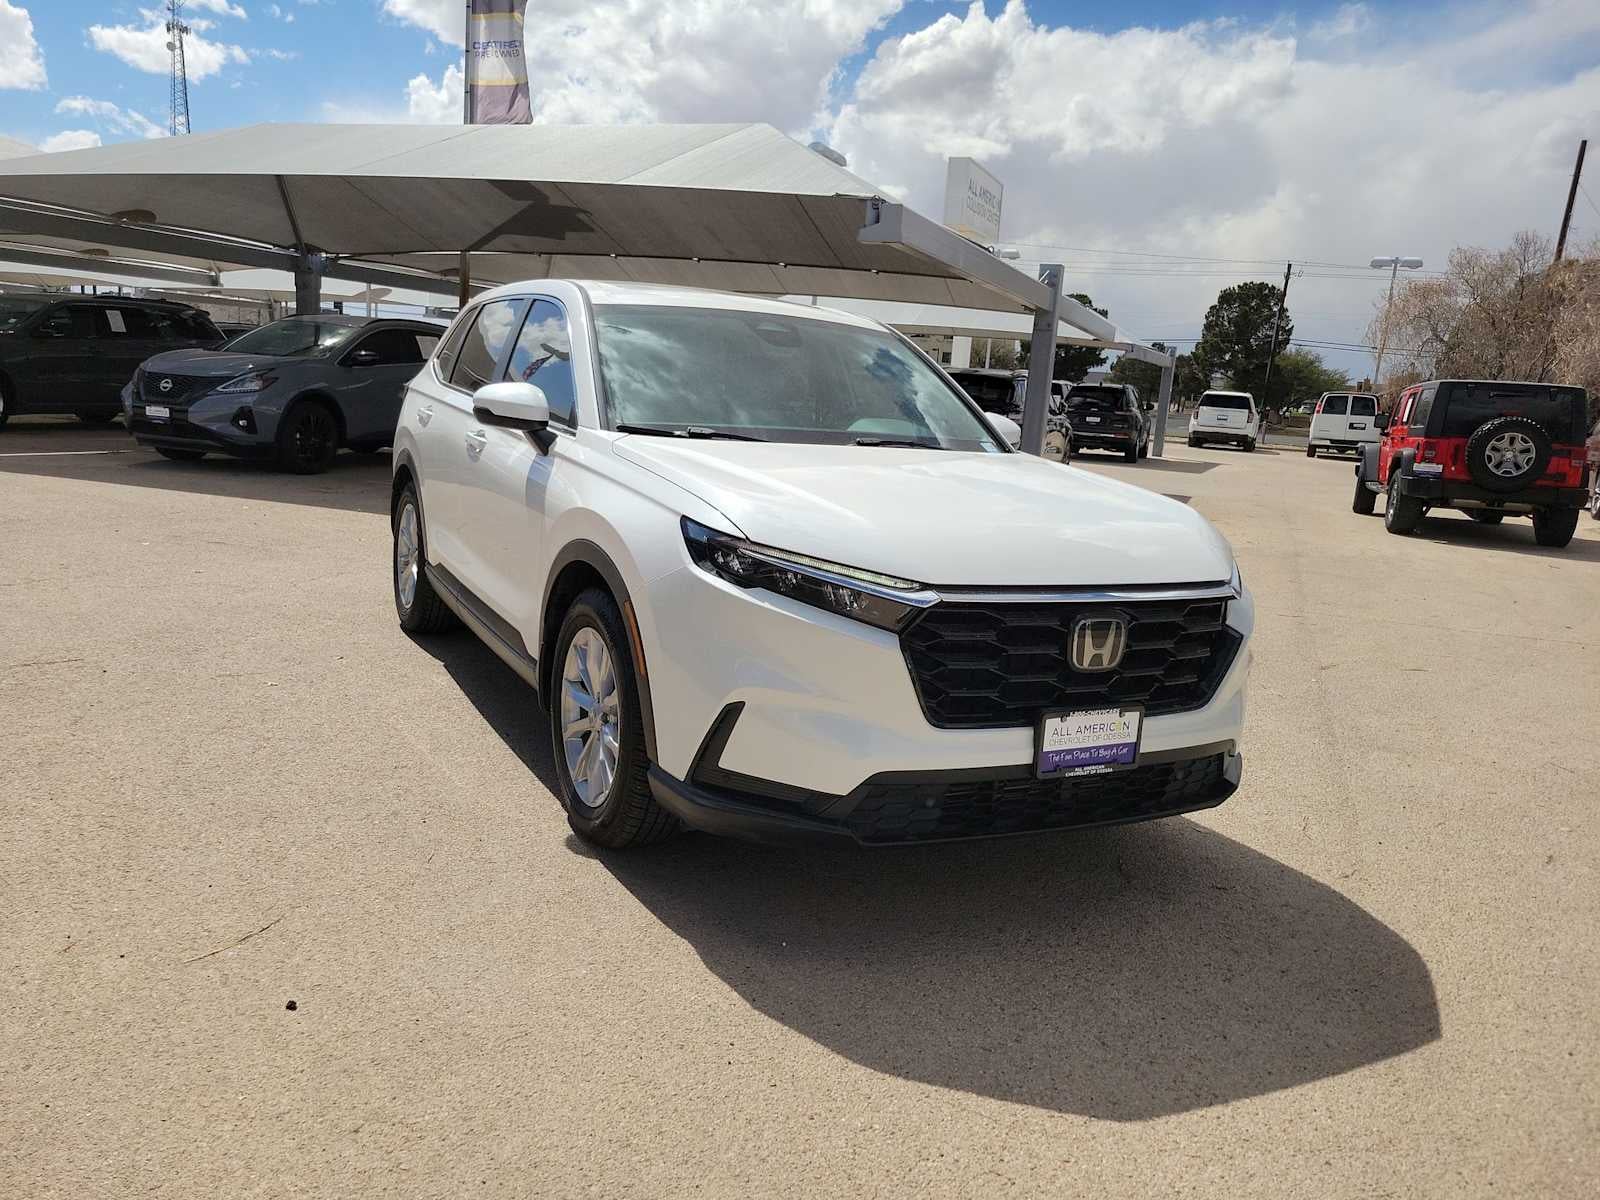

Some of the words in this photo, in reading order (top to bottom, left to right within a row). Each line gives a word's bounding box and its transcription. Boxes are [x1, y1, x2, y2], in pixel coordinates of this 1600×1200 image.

[1048, 735, 1091, 746] CHEVROLET
[1092, 734, 1102, 742] OF
[1102, 732, 1131, 741] ODESSA
[1051, 727, 1072, 738] ALL
[1073, 750, 1090, 760] Place
[1099, 748, 1111, 758] Buy
[1118, 745, 1129, 753] Car
